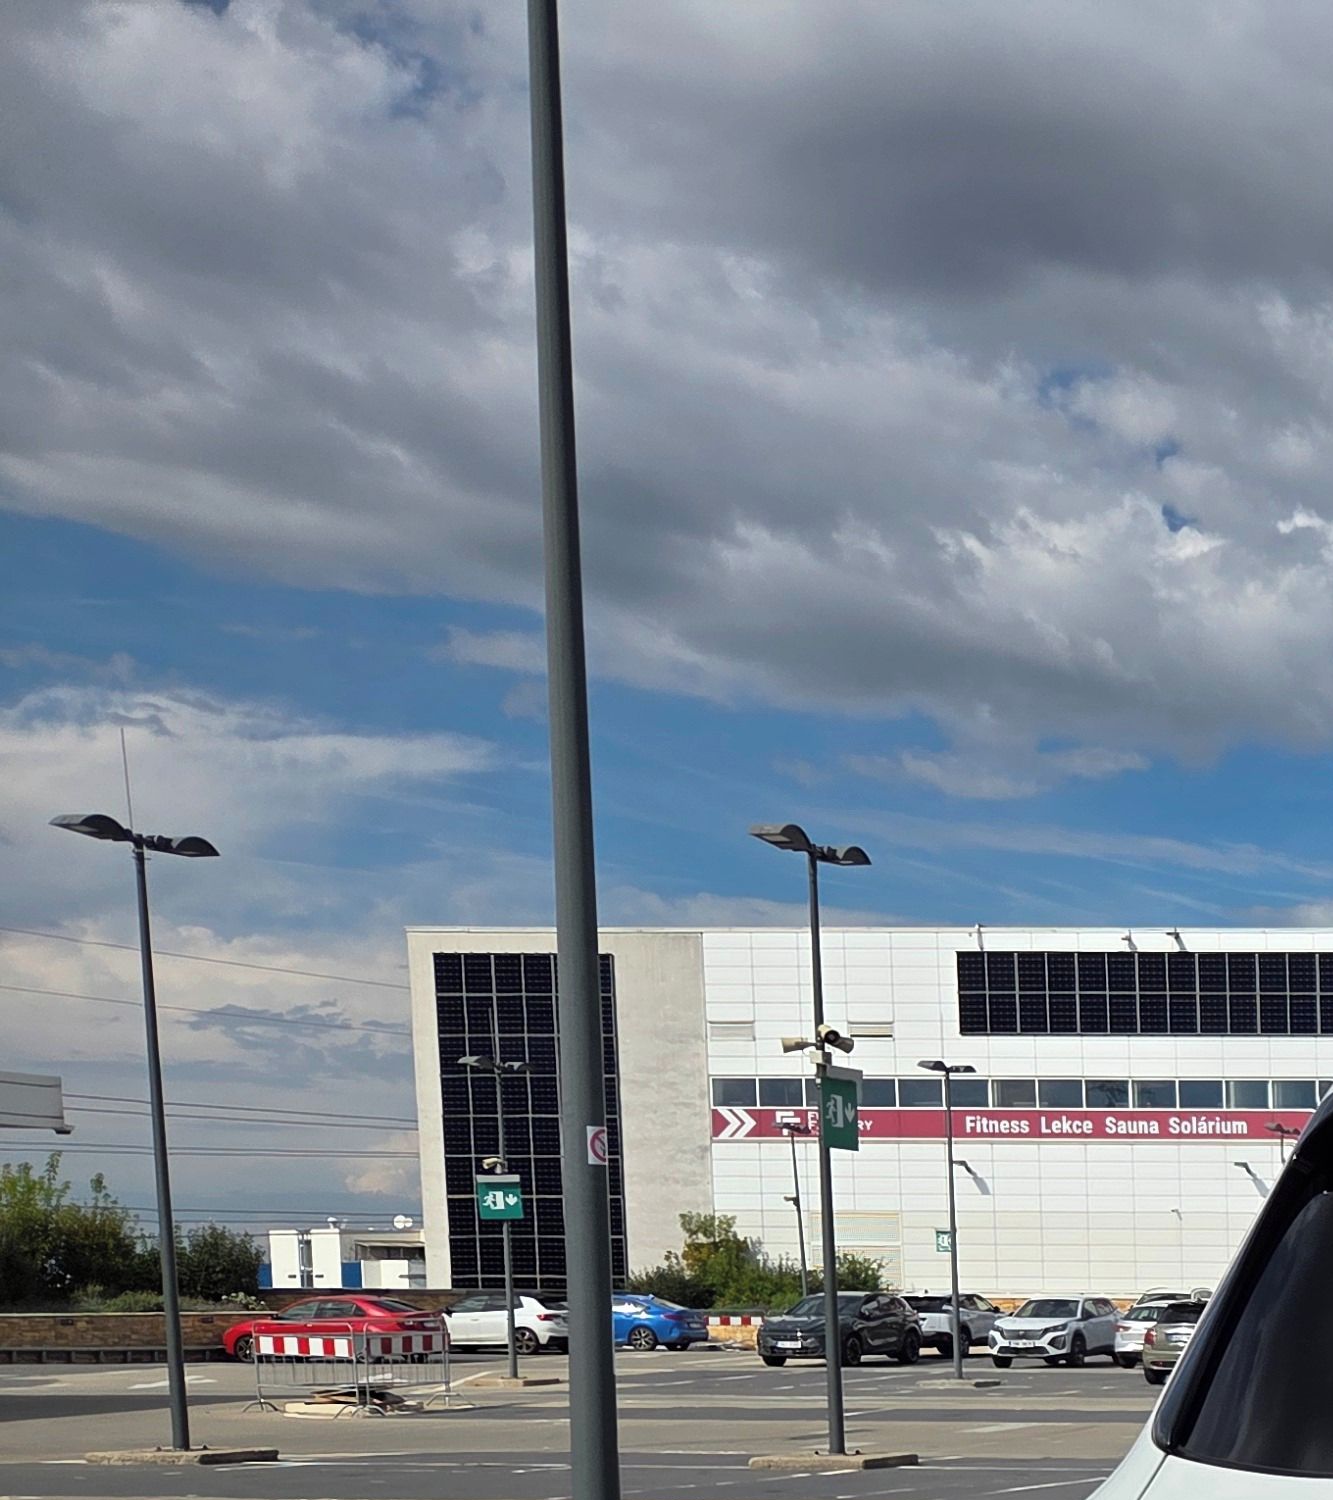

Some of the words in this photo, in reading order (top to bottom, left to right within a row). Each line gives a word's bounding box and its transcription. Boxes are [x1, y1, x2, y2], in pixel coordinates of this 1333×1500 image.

[965, 1115, 1030, 1134] Fitness
[1040, 1116, 1093, 1134] Lekce
[1105, 1117, 1160, 1134] Sauna
[1168, 1116, 1248, 1135] Solárium
